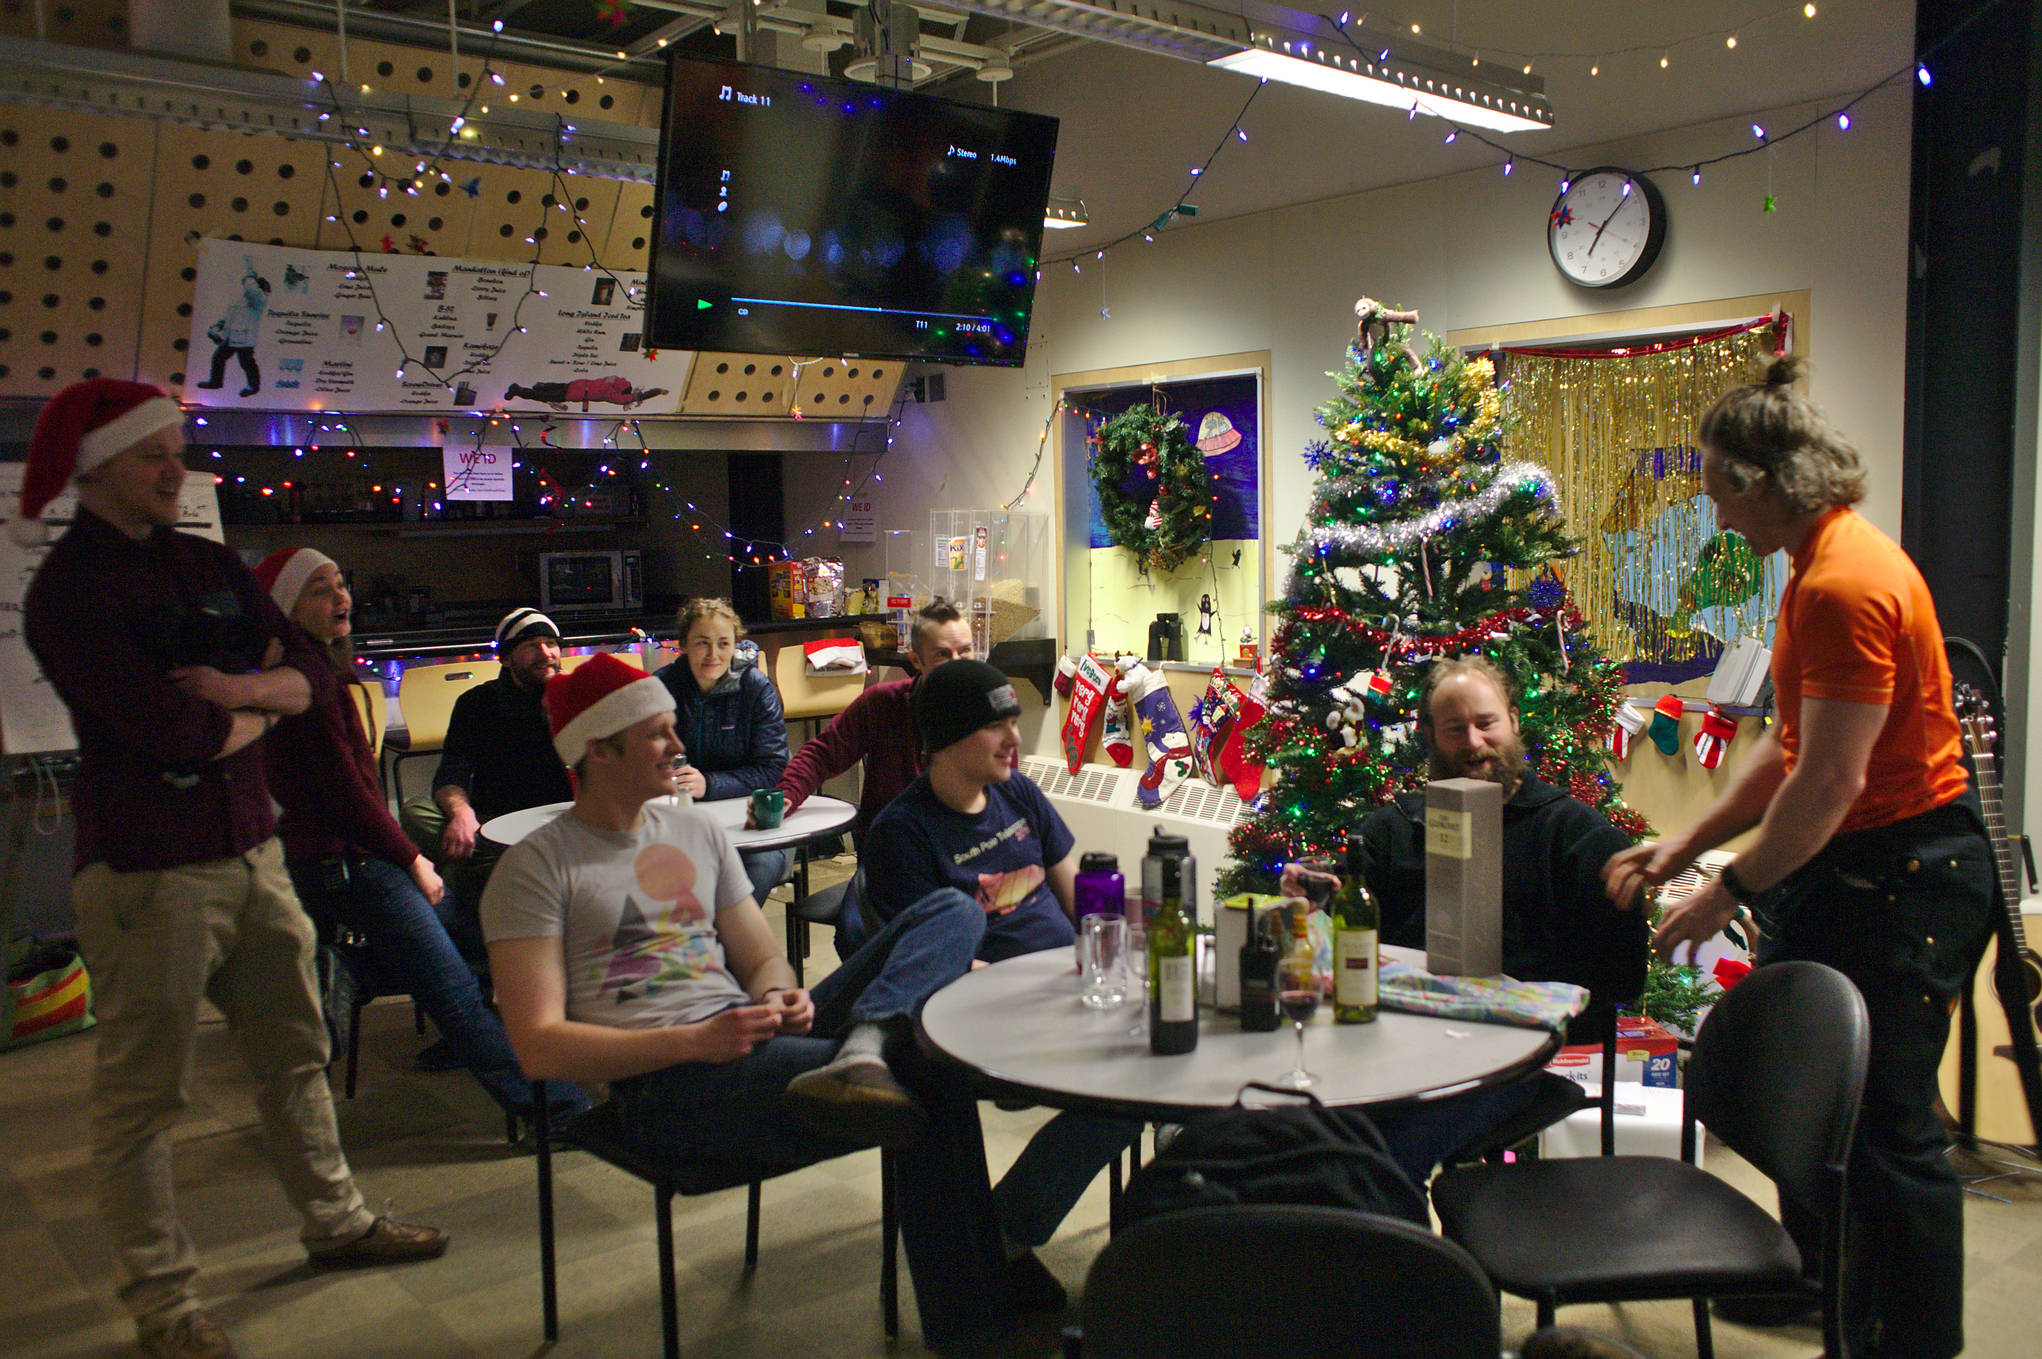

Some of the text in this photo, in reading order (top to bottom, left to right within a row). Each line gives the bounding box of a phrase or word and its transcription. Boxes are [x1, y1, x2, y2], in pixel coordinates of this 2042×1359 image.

[737, 91, 771, 107] Track 11
[957, 147, 1018, 167] Stereo 1.4Mbps
[915, 320, 929, 330] T11
[1650, 1057, 1671, 1071] 20
